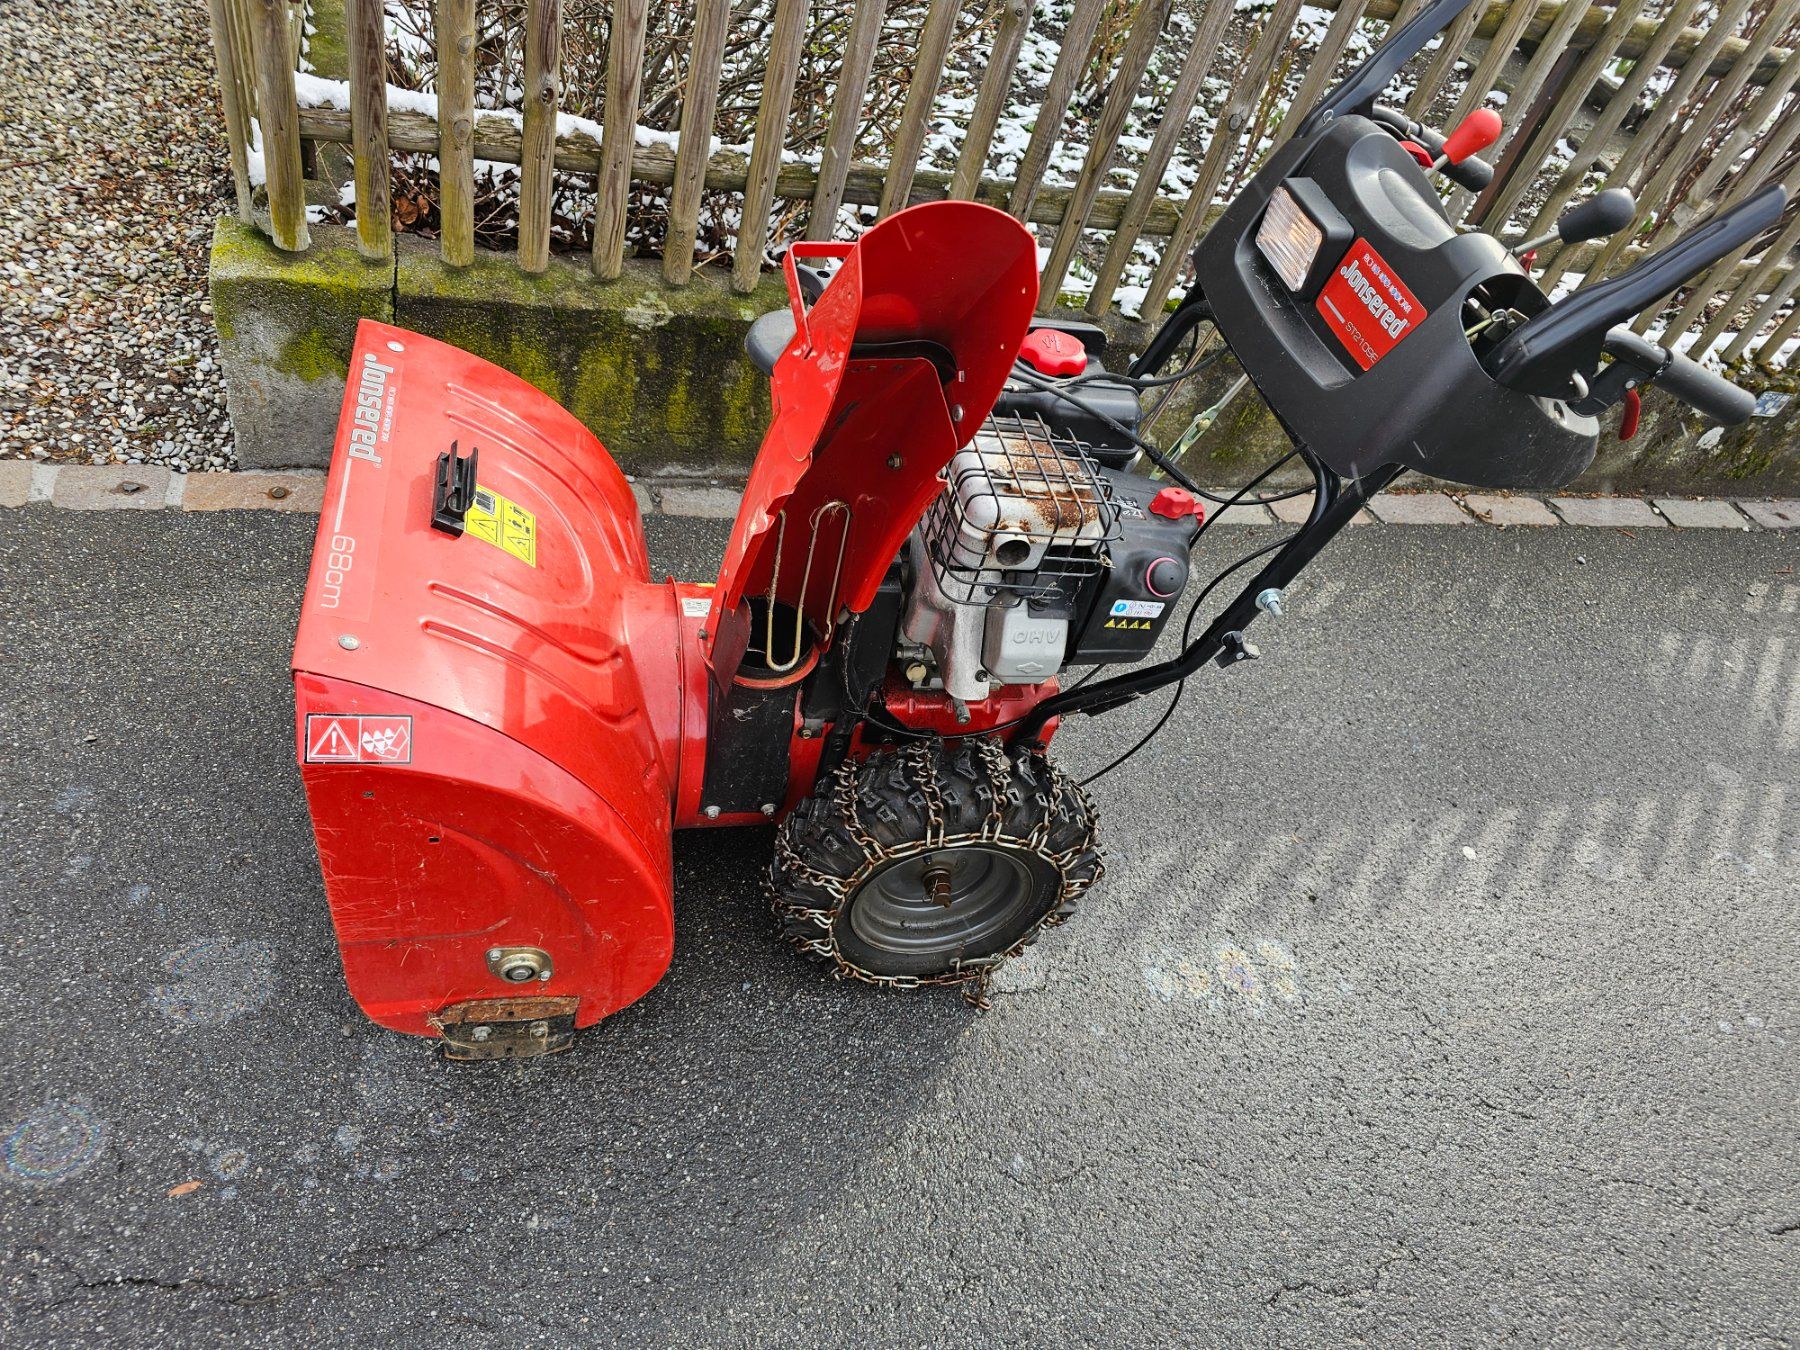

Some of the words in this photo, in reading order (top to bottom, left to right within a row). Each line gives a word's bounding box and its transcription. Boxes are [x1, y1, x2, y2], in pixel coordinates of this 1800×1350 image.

[1340, 259, 1407, 340] Jonsered
[348, 353, 394, 464] Jonsered
[321, 535, 355, 609] 68cm
[1012, 629, 1061, 645] OHV
